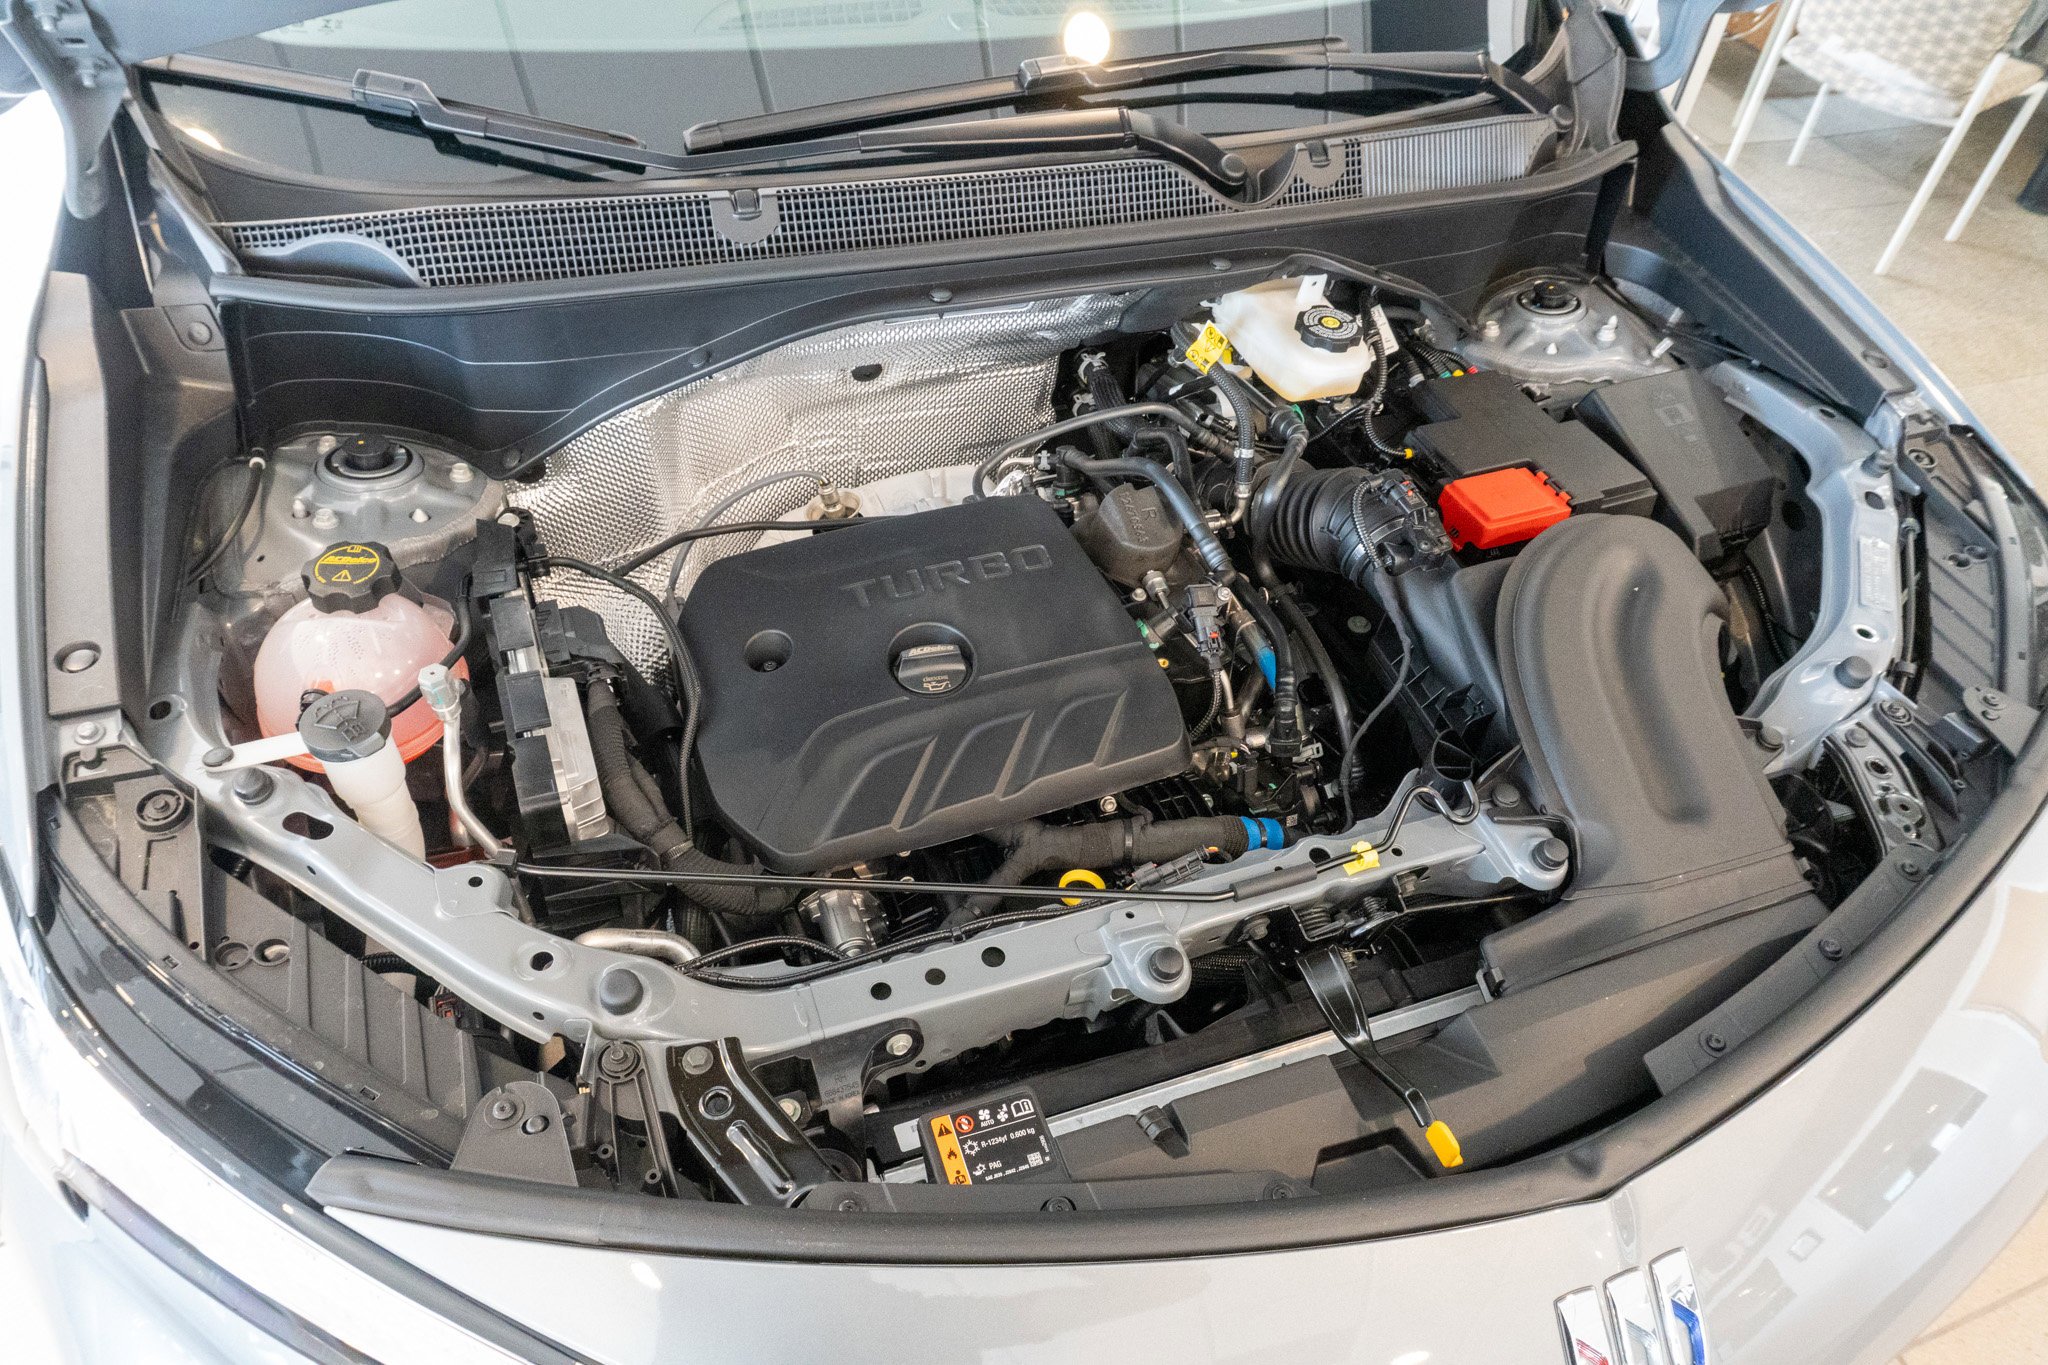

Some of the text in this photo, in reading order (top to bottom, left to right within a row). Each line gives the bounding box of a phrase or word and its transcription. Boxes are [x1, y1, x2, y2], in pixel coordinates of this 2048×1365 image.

[1141, 507, 1157, 521] R
[838, 544, 1052, 608] TURBO
[908, 644, 955, 657] ACDelco
[980, 1118, 995, 1128] AUTO
[980, 1127, 1036, 1149] R-1234yf 0.600 kg
[988, 1160, 1003, 1170] PAG
